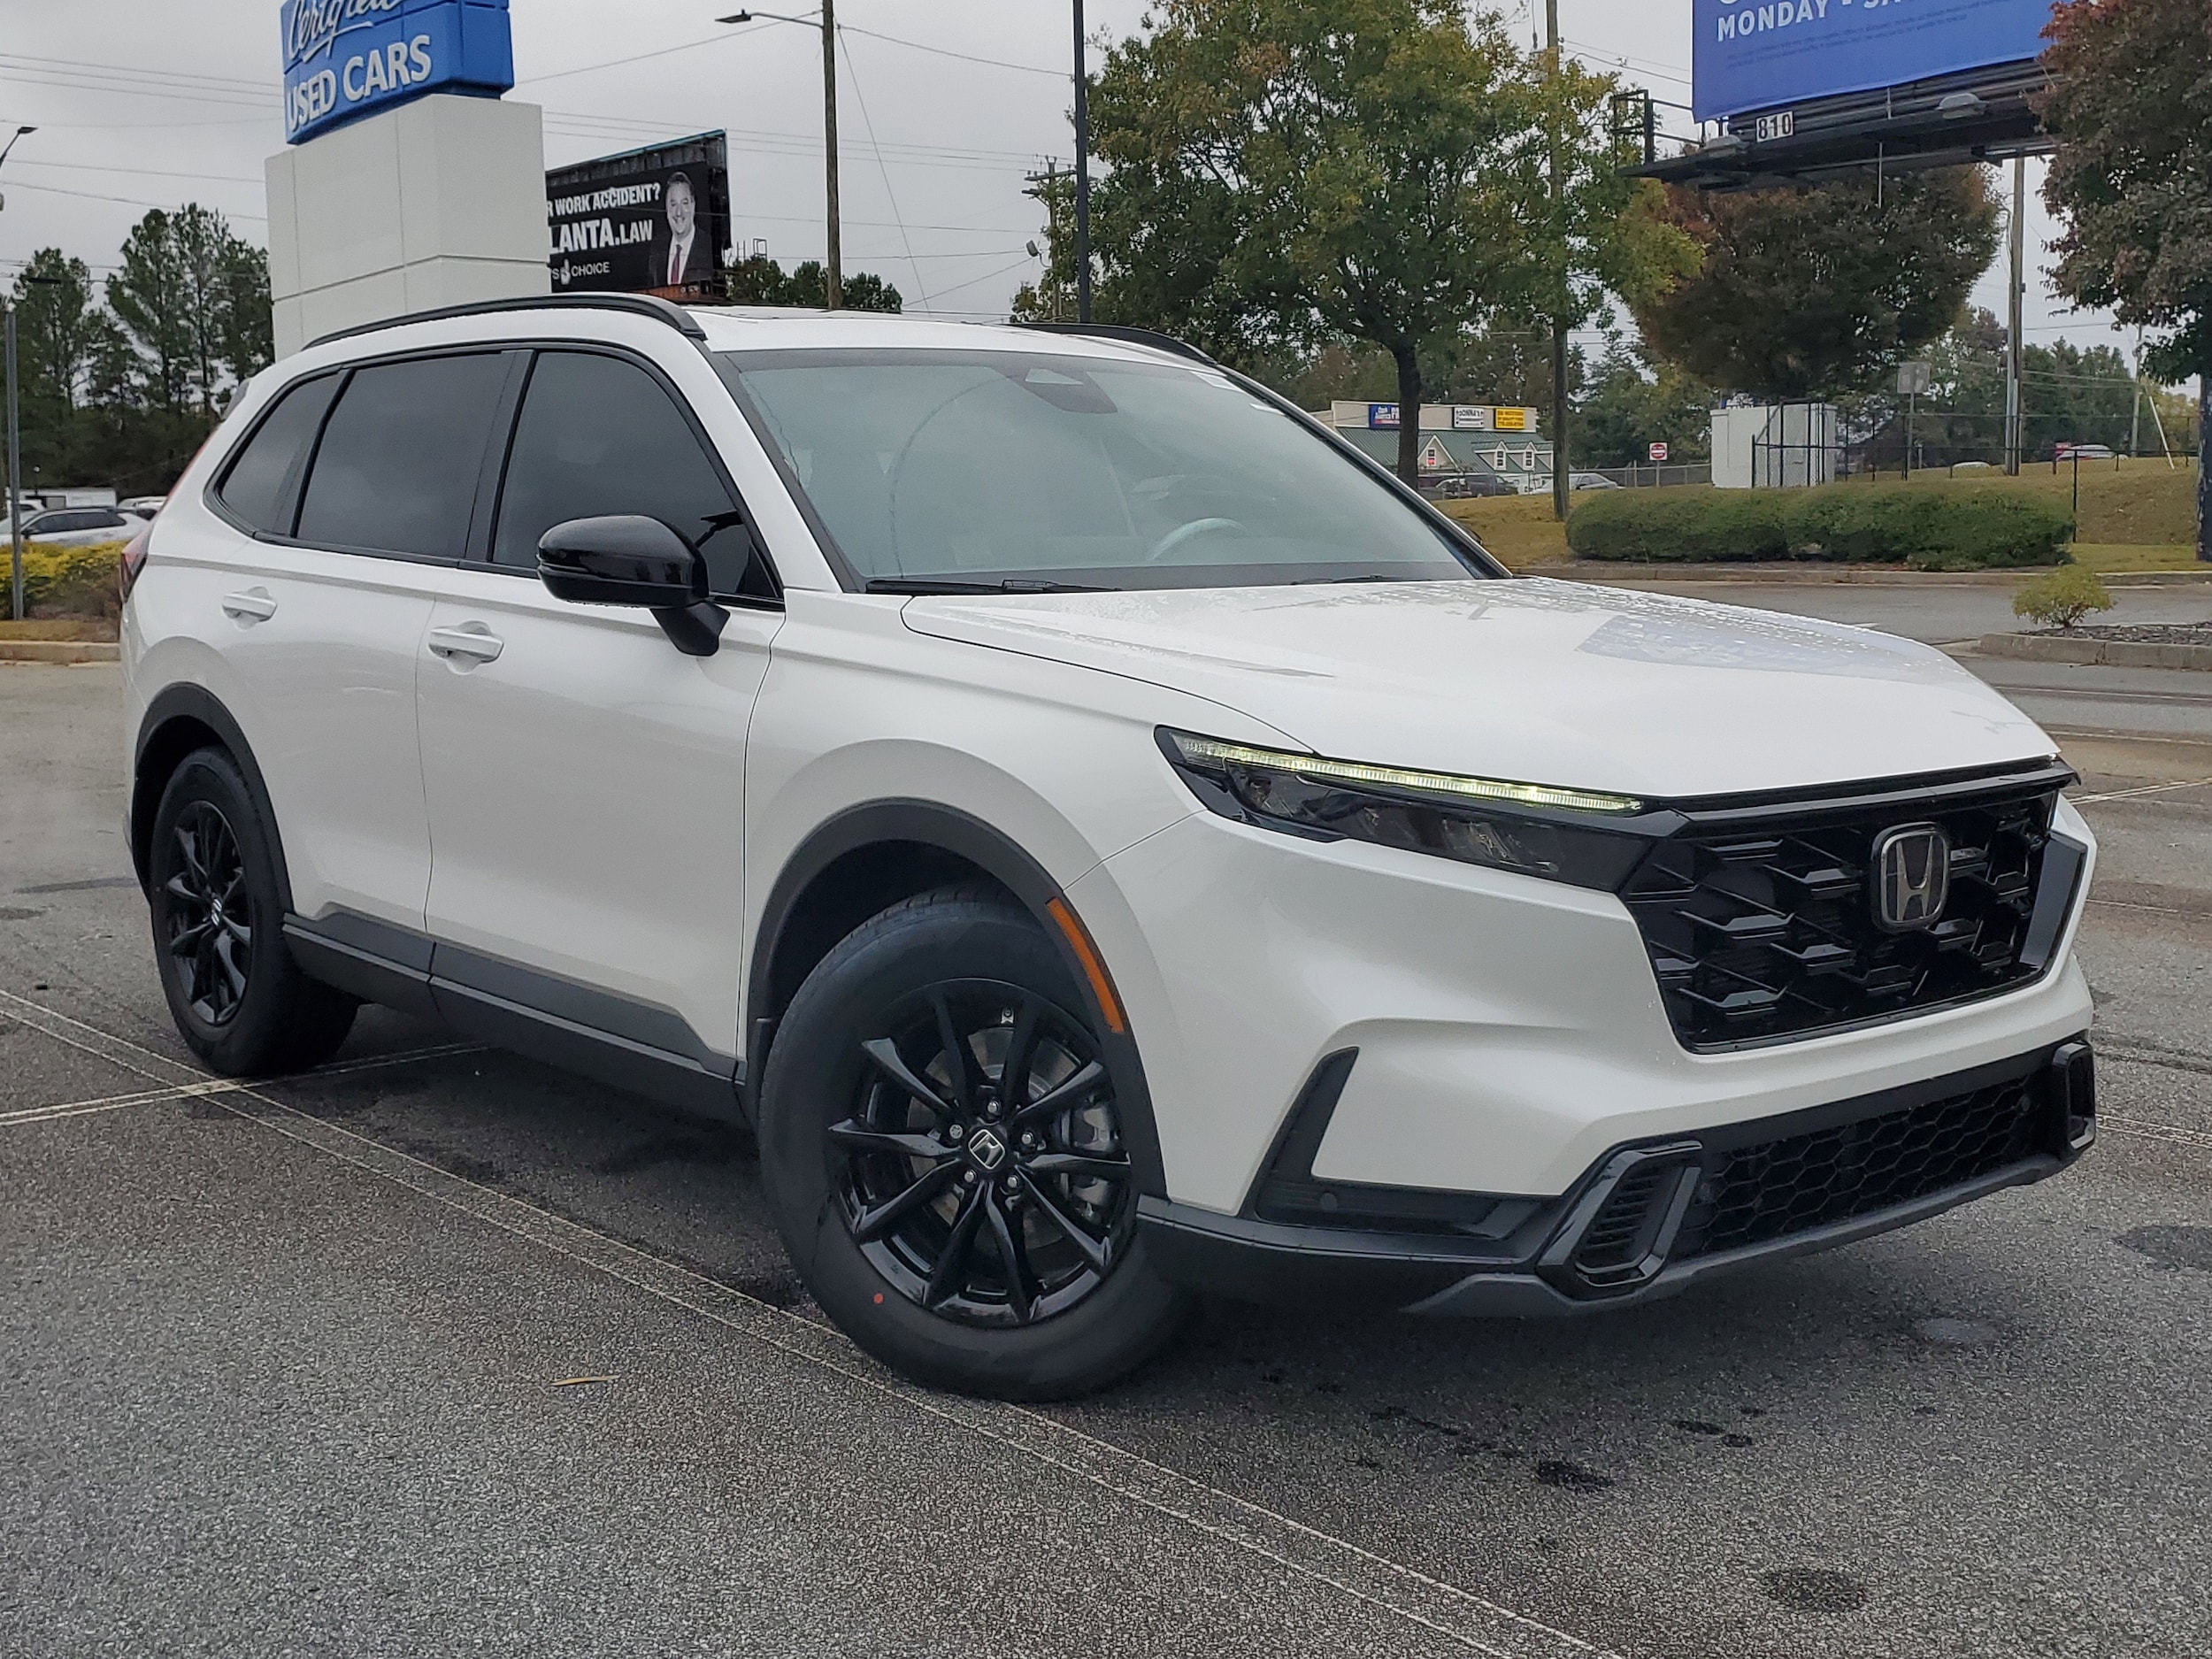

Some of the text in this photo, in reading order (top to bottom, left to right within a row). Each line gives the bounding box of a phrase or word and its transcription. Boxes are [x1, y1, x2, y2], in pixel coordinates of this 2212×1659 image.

[1717, 0, 1828, 42] MONDAY
[287, 35, 432, 132] USED CARS
[1757, 114, 1792, 140] 810
[555, 194, 591, 216] WORK
[592, 182, 661, 211] ACCIDENT?
[571, 262, 611, 278] CHOICE
